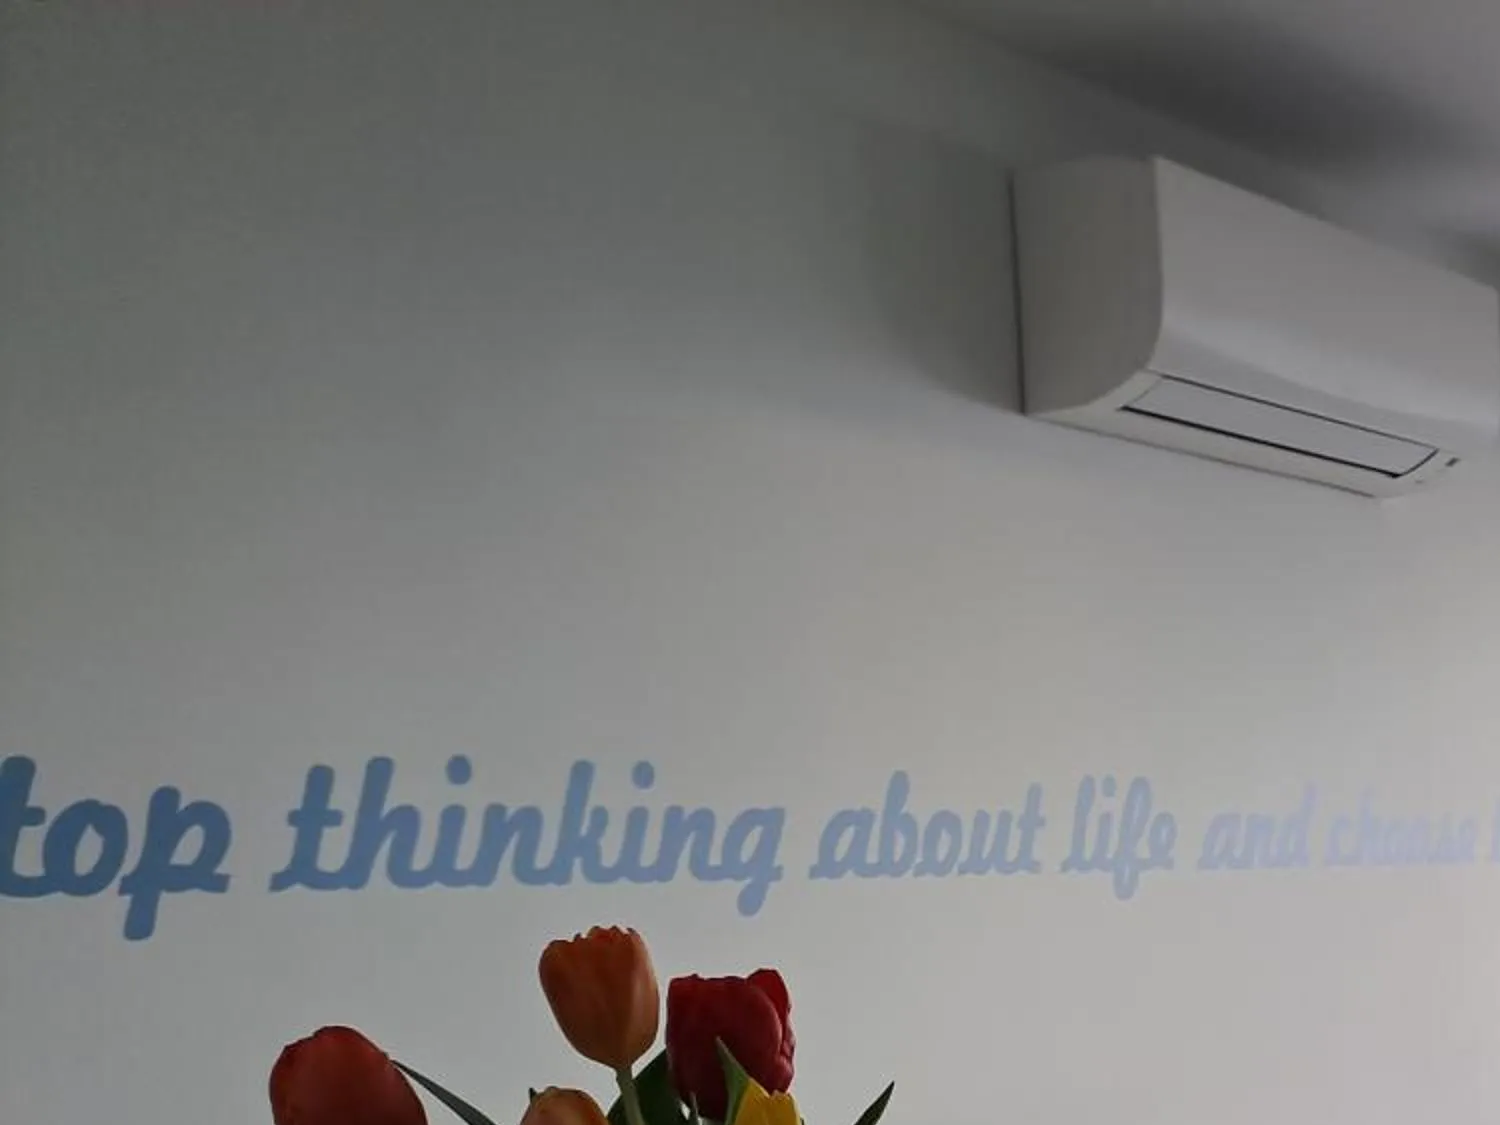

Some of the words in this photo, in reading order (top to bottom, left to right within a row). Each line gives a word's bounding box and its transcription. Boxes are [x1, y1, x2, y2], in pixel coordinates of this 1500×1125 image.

[269, 754, 786, 917] thinking
[808, 769, 1046, 880] about
[1058, 773, 1178, 901] life
[1196, 782, 1320, 871] and
